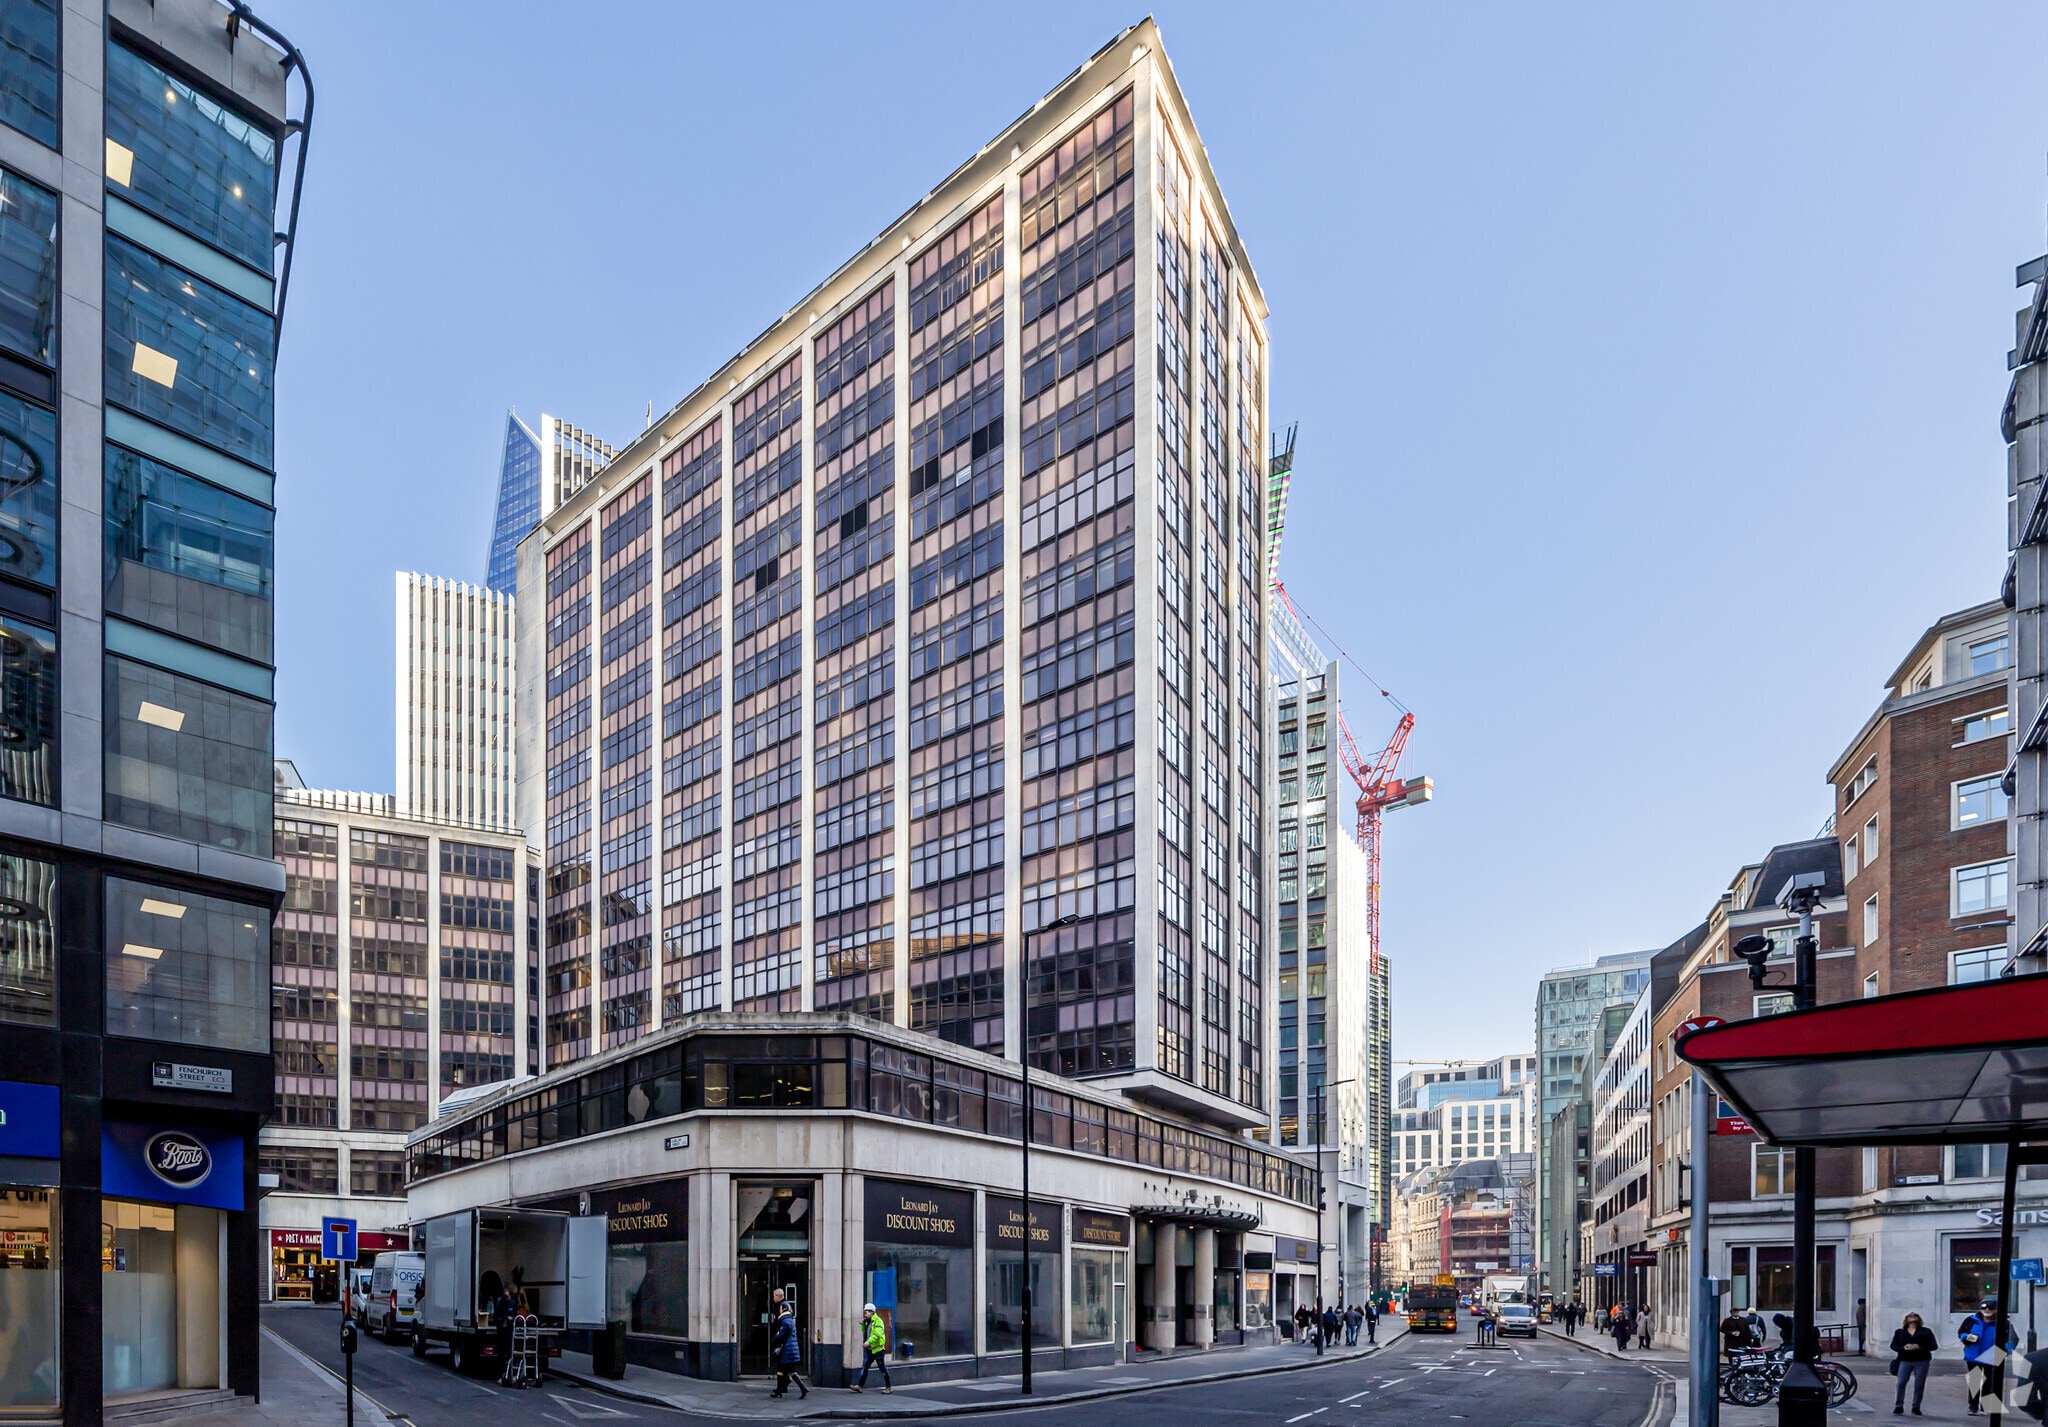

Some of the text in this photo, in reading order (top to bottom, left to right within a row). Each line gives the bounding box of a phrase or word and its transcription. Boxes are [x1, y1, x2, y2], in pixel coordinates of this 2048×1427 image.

[178, 1066, 222, 1077] FENCHURCH
[179, 1073, 205, 1081] STREET
[158, 1140, 203, 1171] Boots
[608, 1213, 668, 1232] DISCOUNT SHOES
[886, 1213, 955, 1233] DISCOUNT SHOES
[286, 1233, 298, 1243] PRET
[300, 1234, 304, 1243] A
[998, 1224, 1049, 1241] DISCOUN SHOES
[1083, 1228, 1107, 1240] DISCOUNT
[400, 1271, 423, 1281] OASIS
